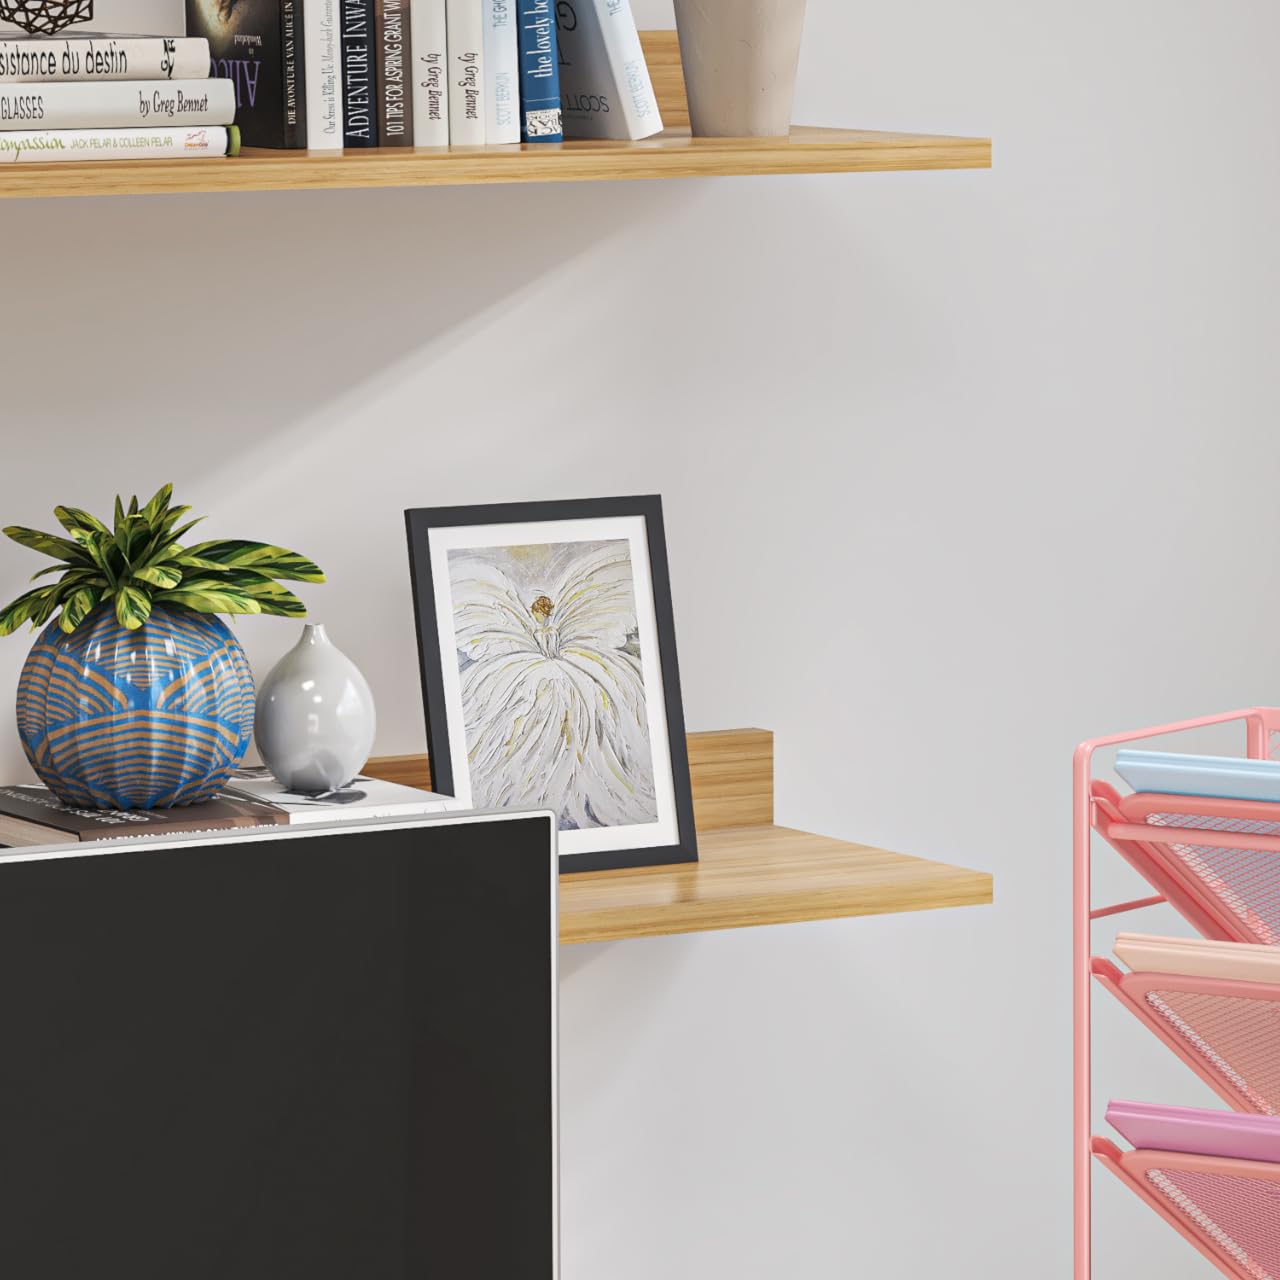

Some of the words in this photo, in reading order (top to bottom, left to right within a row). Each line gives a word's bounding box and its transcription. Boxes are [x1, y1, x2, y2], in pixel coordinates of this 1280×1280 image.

[384, 13, 403, 42] GRANT
[524, 17, 554, 55] lovely
[62, 40, 80, 75] du
[85, 39, 128, 74] destin
[384, 43, 403, 82] ASPIRING
[421, 53, 441, 64] by
[458, 52, 478, 64] by
[528, 56, 553, 78] the
[421, 66, 442, 88] Greg
[458, 65, 479, 87] Greg
[345, 45, 370, 138] ADVENTURE
[385, 84, 404, 100] FOR
[1, 95, 44, 120] GLASSES
[139, 90, 151, 118] by
[153, 90, 175, 118] Greg
[177, 89, 208, 112] Bennet
[386, 103, 404, 119] TIPS
[428, 89, 442, 121] Bennet
[465, 89, 479, 120] Bennet
[386, 121, 405, 136] 101
